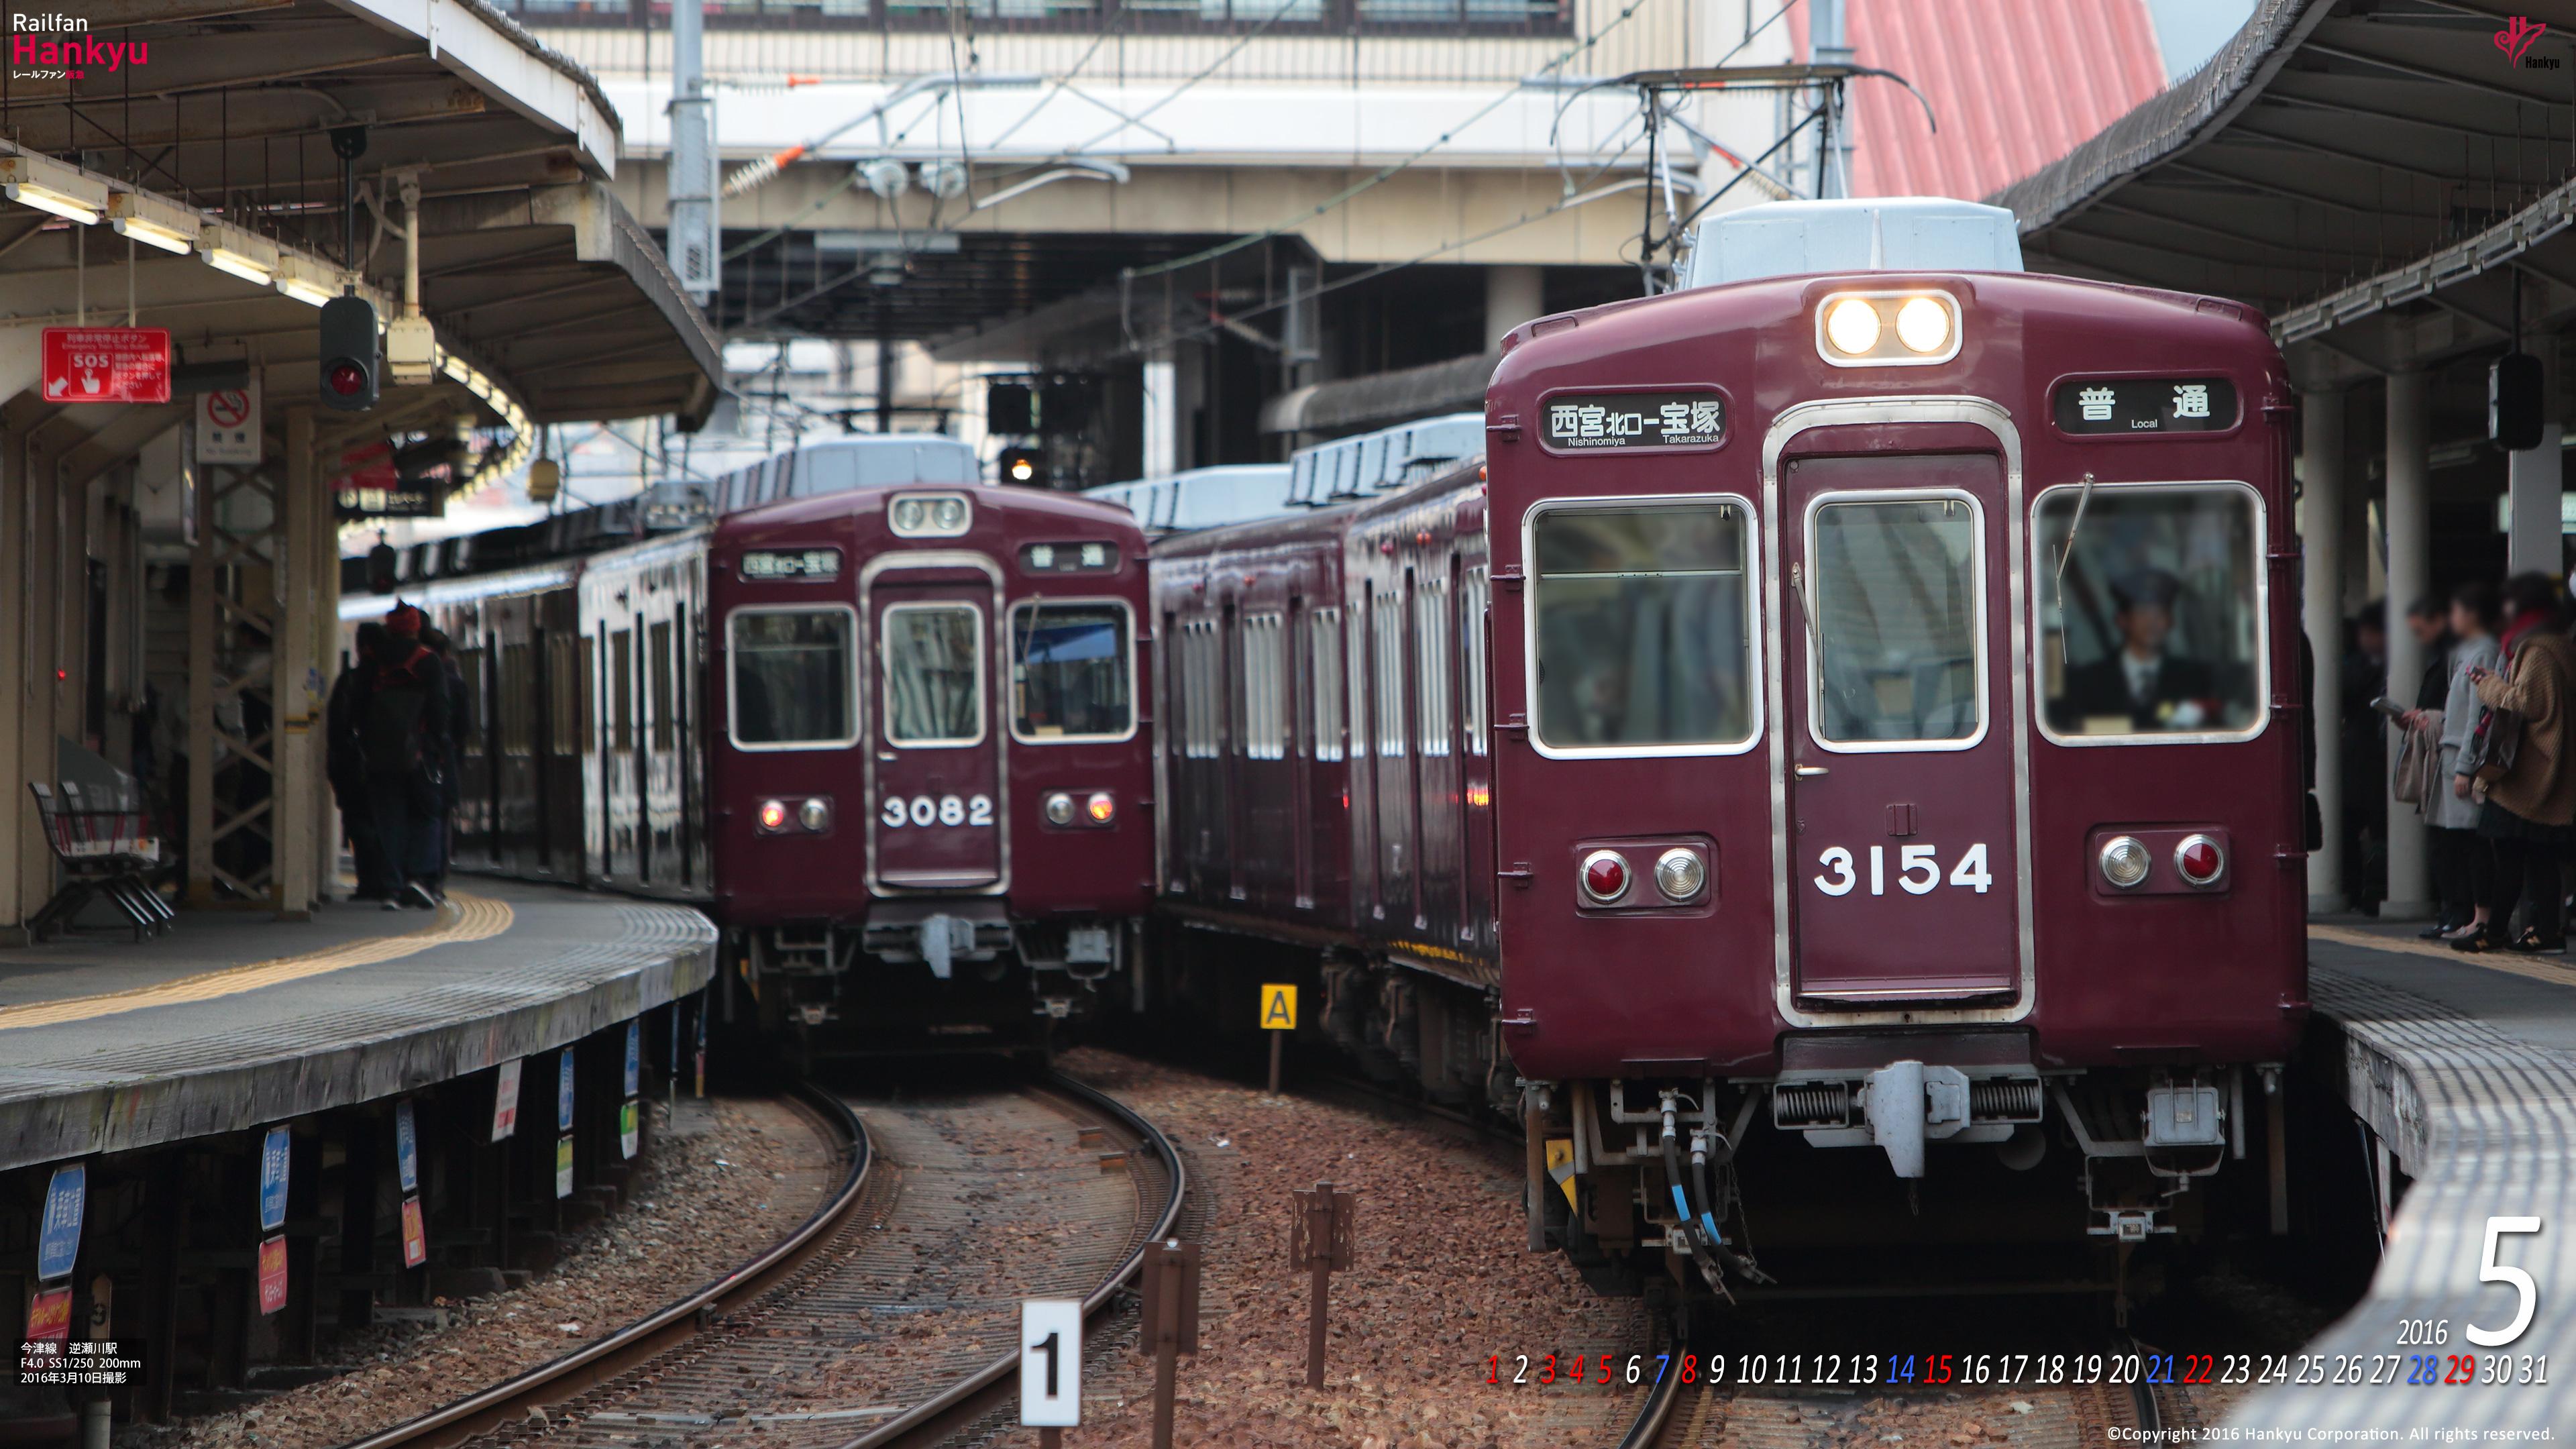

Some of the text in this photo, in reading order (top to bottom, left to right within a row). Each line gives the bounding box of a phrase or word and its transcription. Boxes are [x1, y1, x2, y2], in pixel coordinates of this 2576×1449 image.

[74, 354, 109, 368] SOS
[2079, 384, 2210, 421] 普 通
[2131, 419, 2158, 429] Local
[1568, 434, 1719, 447] Nishinomiya Takarazuka
[881, 795, 994, 826] 3082
[1814, 843, 1992, 896] 3154
[1265, 991, 1289, 1025] A
[1030, 1332, 1058, 1397] 1
